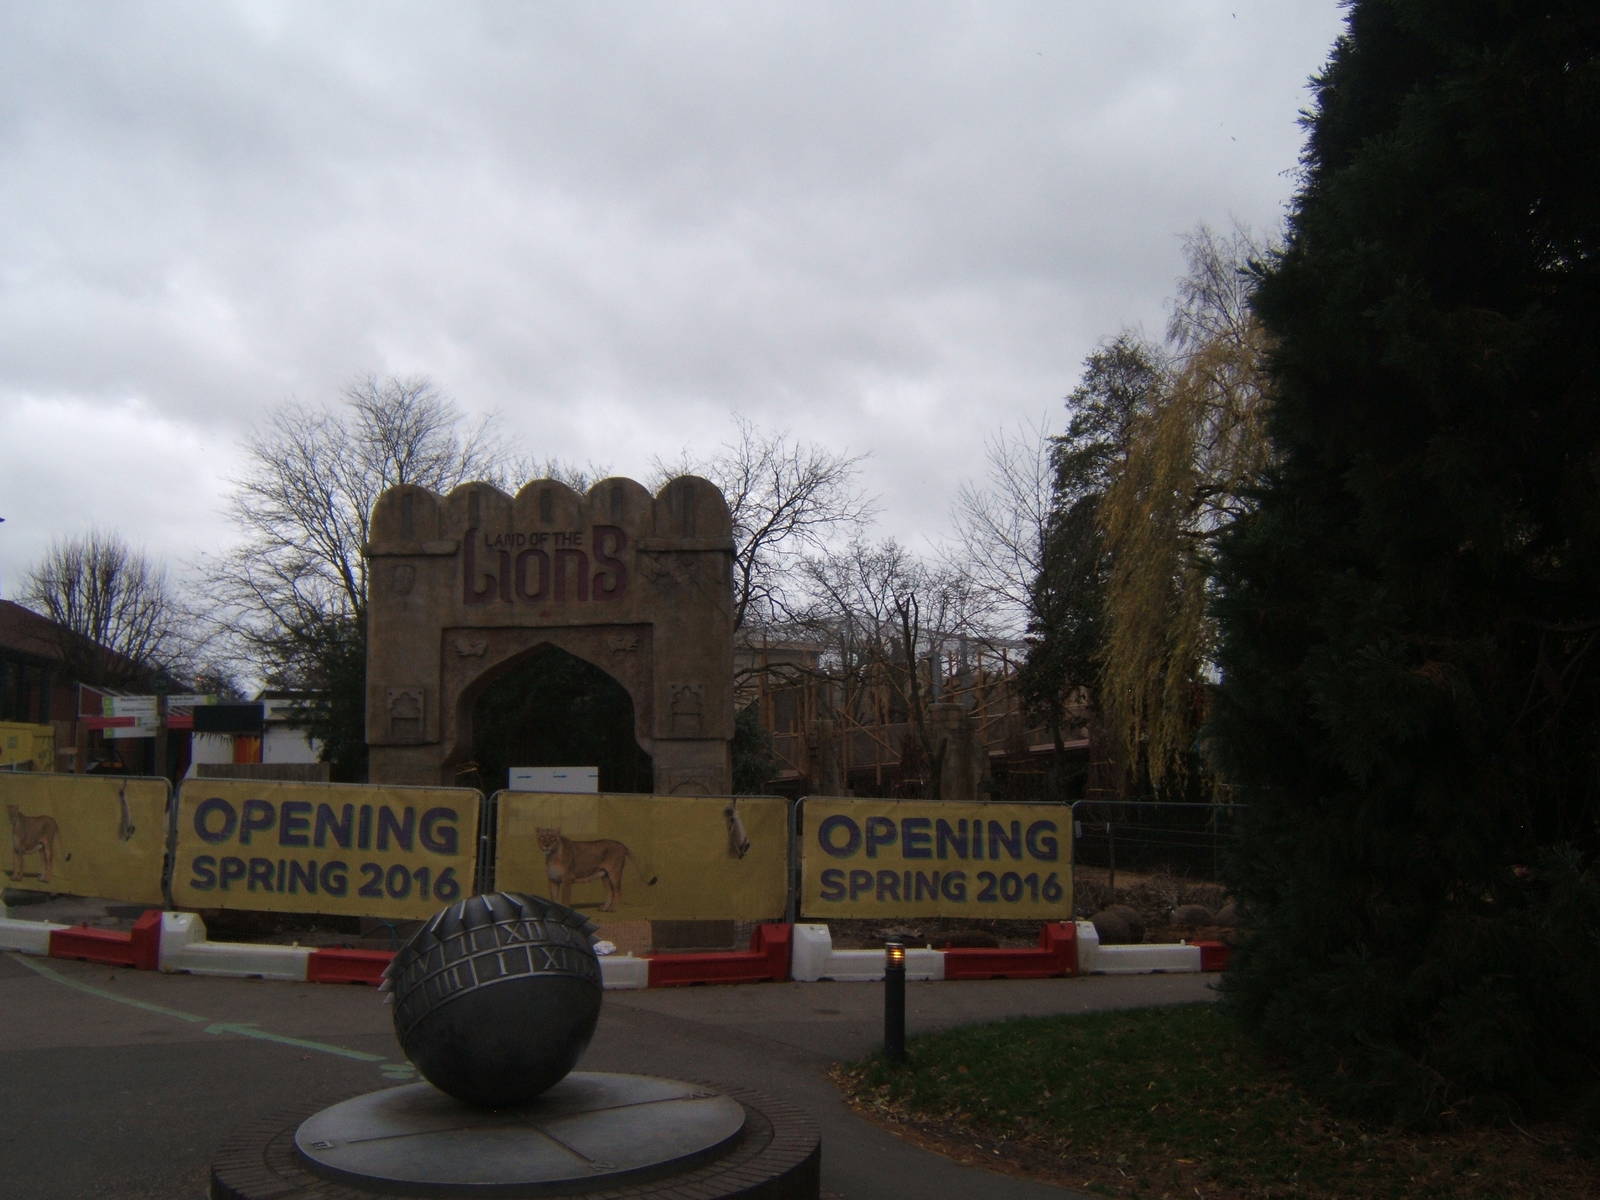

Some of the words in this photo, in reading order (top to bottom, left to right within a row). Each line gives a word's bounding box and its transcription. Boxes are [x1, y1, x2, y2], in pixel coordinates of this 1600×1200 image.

[484, 532, 526, 548] LAND
[528, 531, 550, 546] OF
[551, 531, 584, 546] THE
[193, 797, 459, 855] OPENING
[818, 815, 1059, 861] OPENING
[189, 855, 349, 897] SPRING
[357, 862, 461, 901] 2016
[820, 868, 968, 902] SPRING
[976, 871, 1064, 902] 2016
[502, 920, 544, 944] XII
